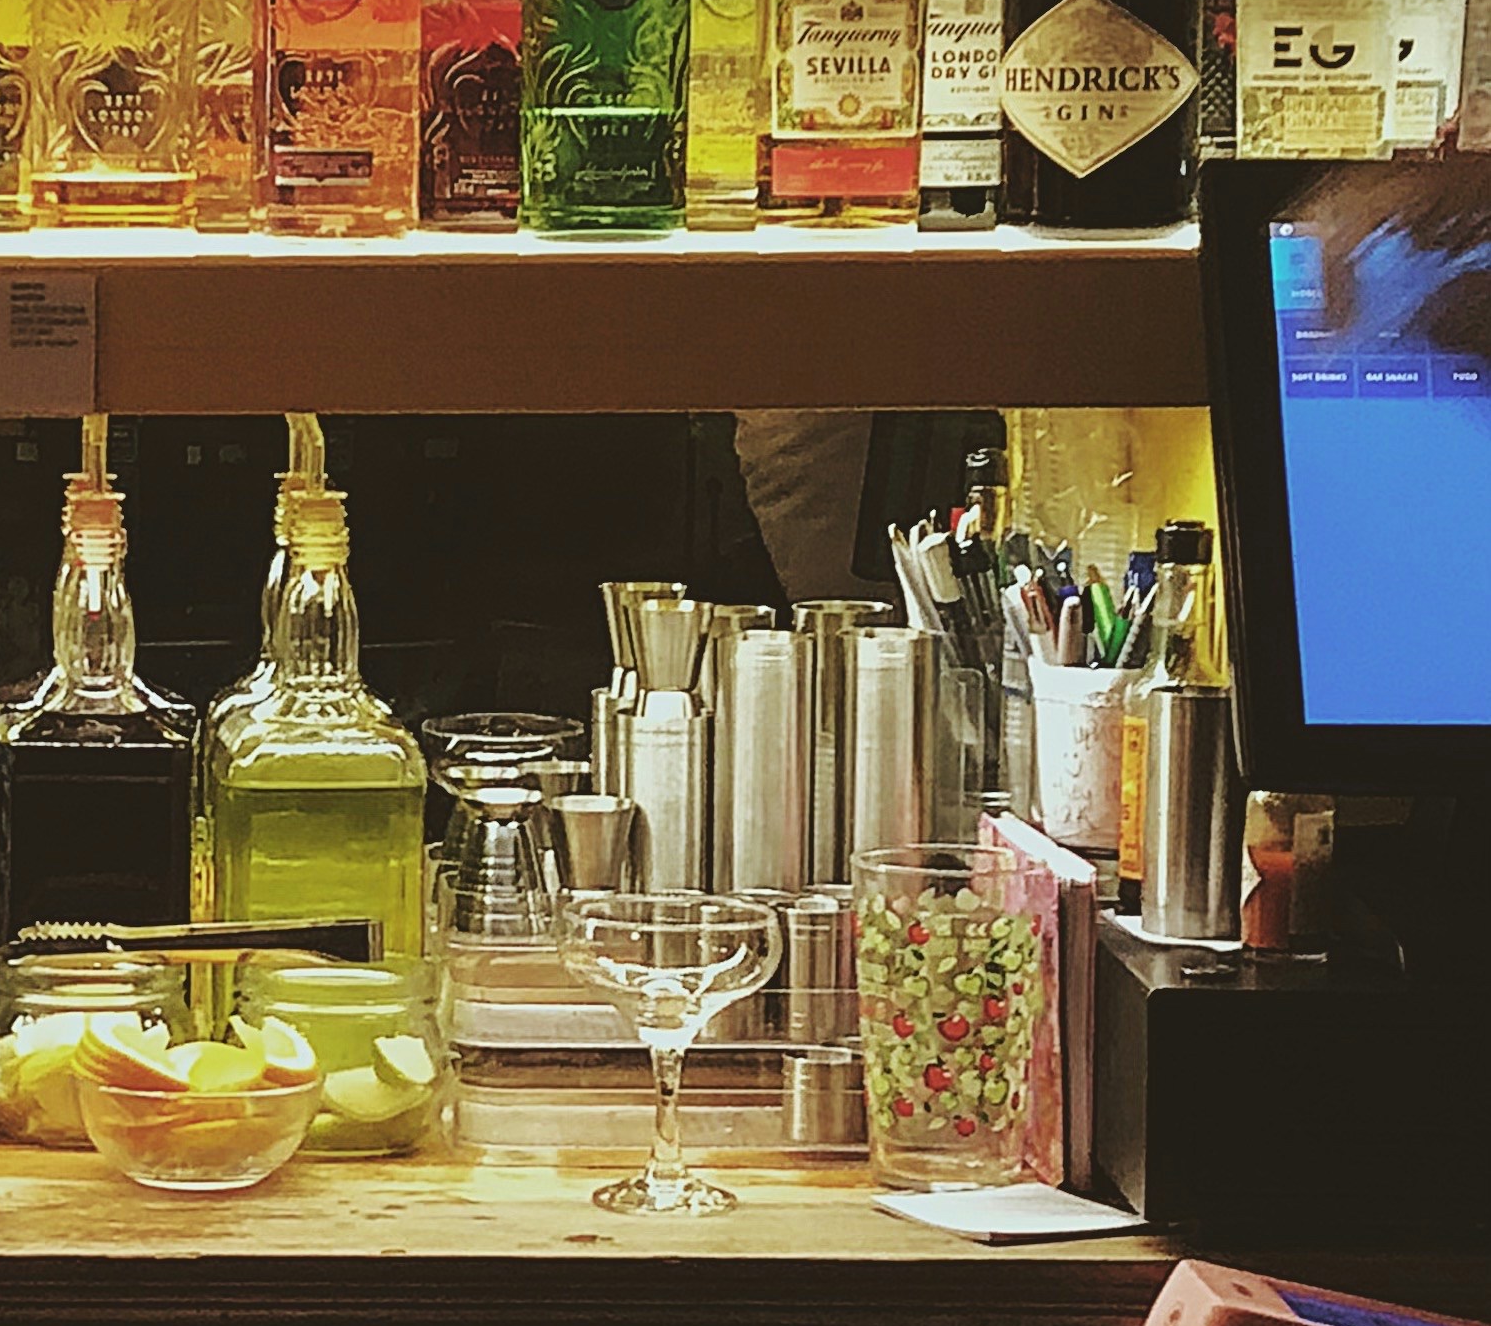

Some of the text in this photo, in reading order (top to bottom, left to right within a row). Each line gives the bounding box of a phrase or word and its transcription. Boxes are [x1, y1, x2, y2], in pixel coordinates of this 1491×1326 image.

[797, 20, 902, 48] Tanqueray
[806, 56, 892, 76] SEVILLA
[931, 65, 970, 80] DRY
[1005, 64, 1182, 93] HENDRICK'S
[1056, 103, 1116, 122] GIN
